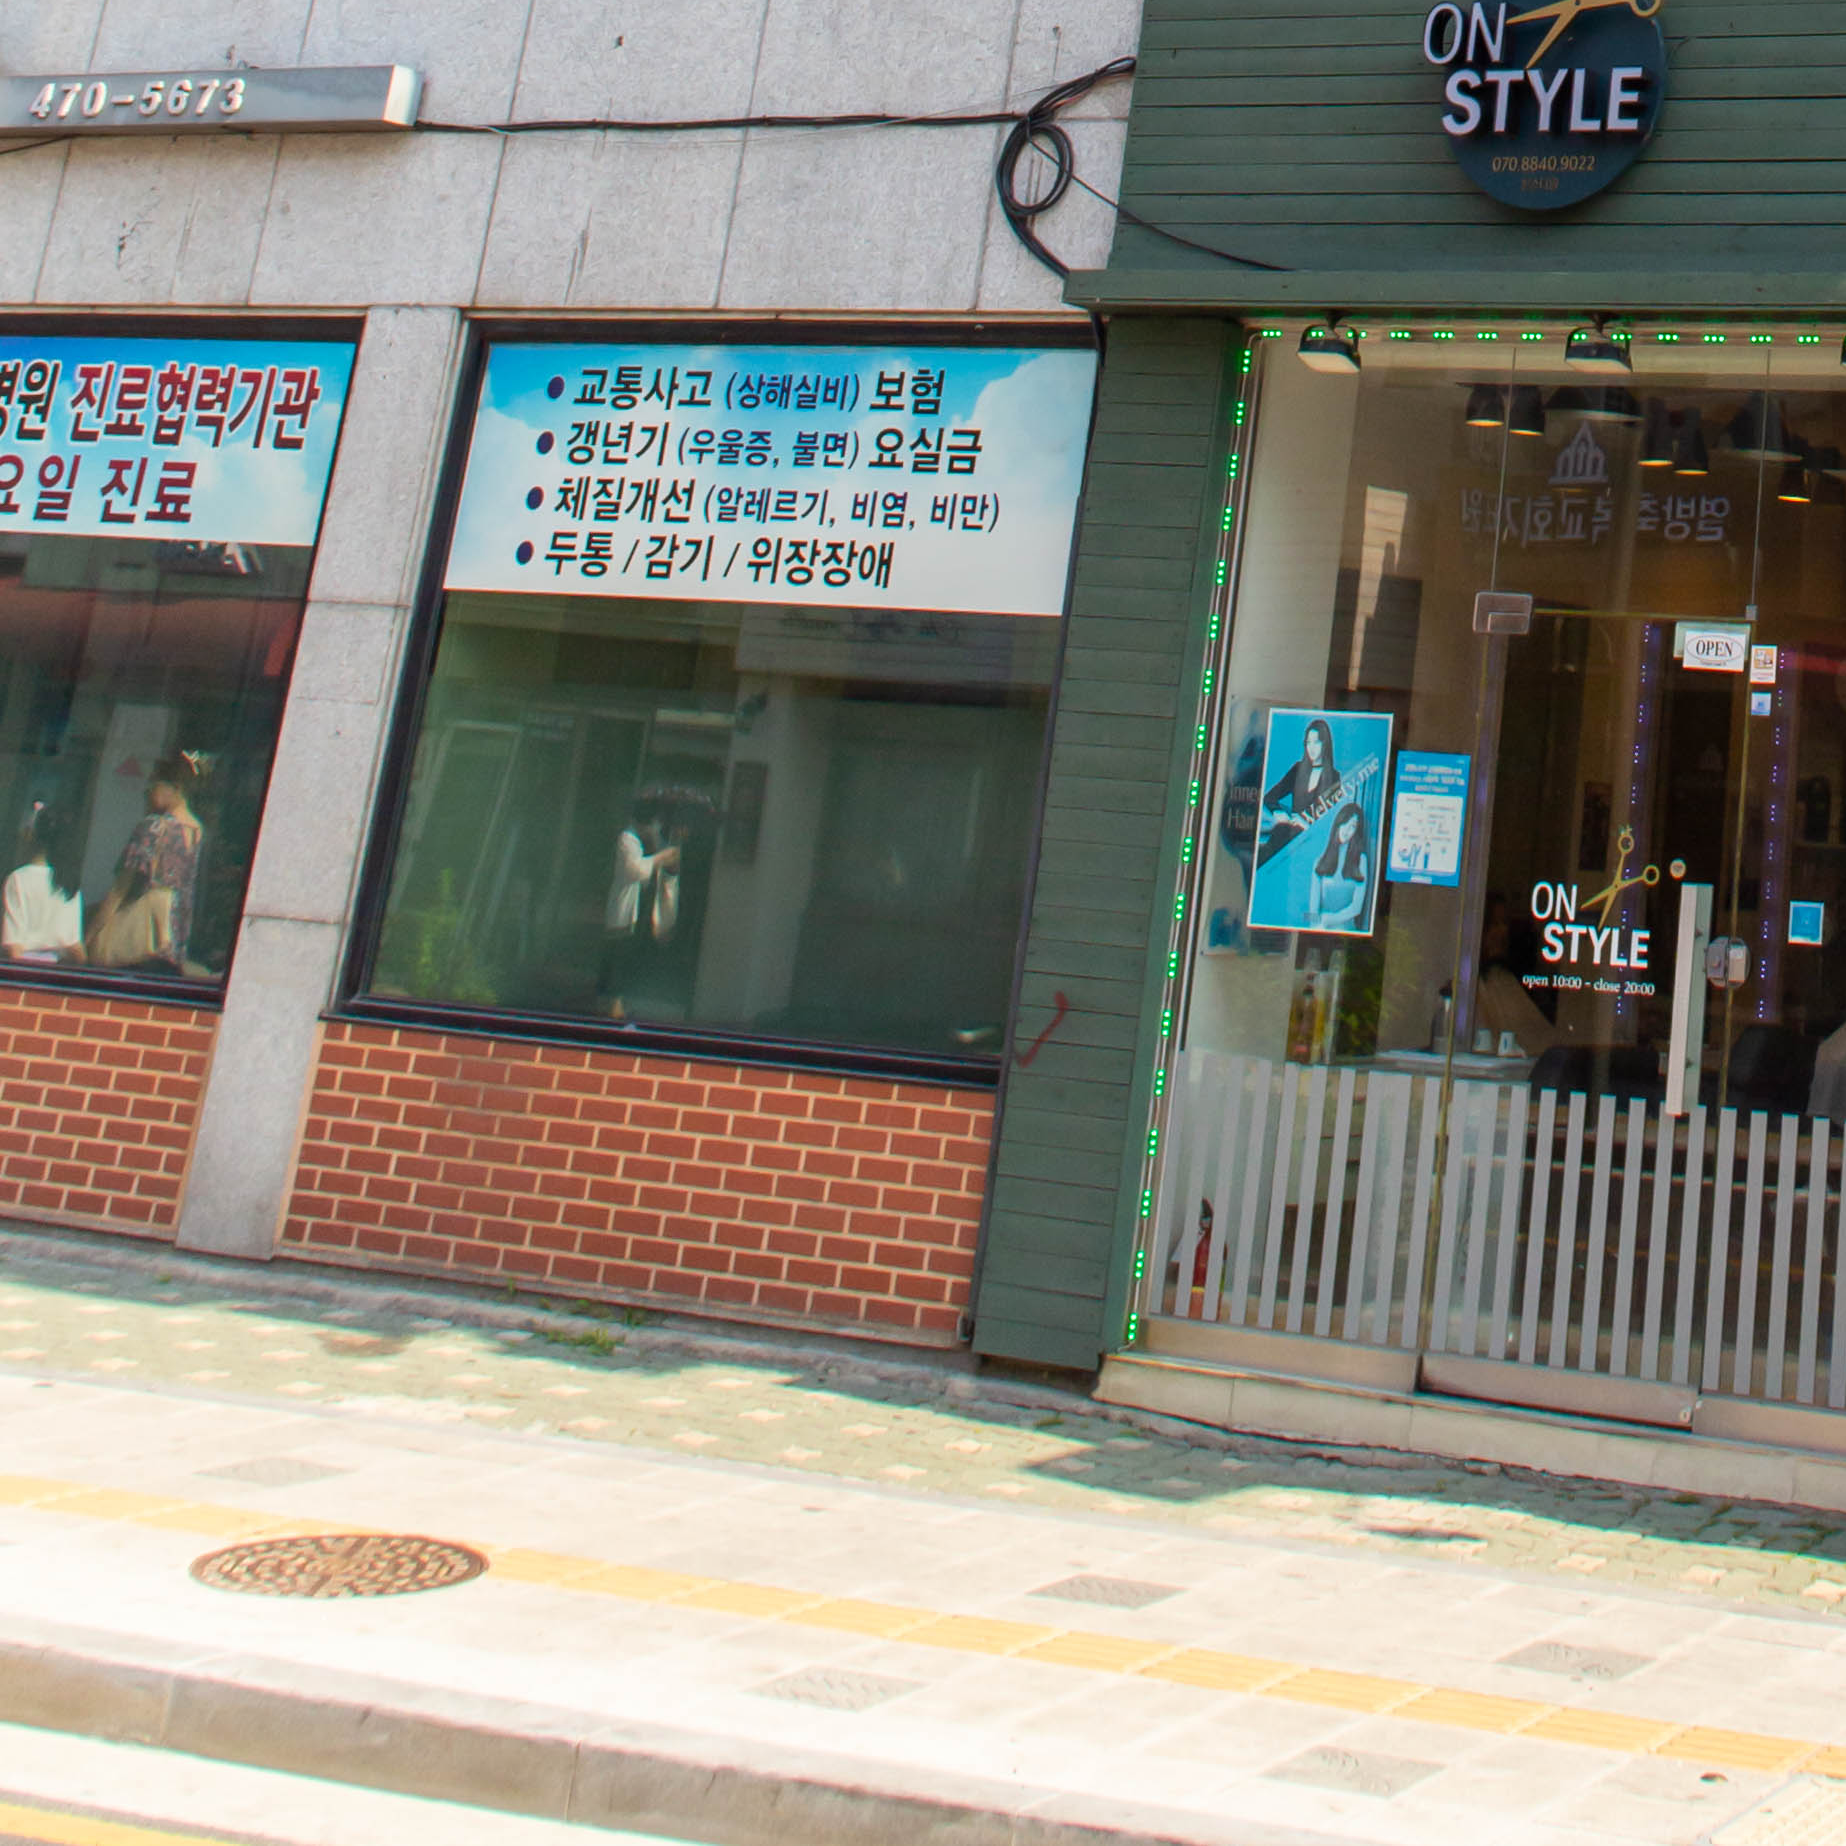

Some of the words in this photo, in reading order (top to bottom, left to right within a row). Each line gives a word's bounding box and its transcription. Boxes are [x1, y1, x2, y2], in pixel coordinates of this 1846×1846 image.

[1423, 2, 1507, 65] ON
[29, 77, 246, 119] 470-5673
[1441, 66, 1644, 136] STYLE
[69, 362, 322, 451] 진료협력기관
[573, 365, 714, 411] 교통사고
[726, 371, 861, 413] (상해실비)
[868, 368, 947, 416] 보험
[567, 419, 671, 467] 갱년기
[678, 426, 781, 469] (우울증,
[791, 430, 860, 470] 불면)
[868, 427, 984, 475] 요실금
[99, 456, 199, 524] 진료
[554, 475, 697, 524] 체질개선
[703, 483, 837, 529] (알레르기,
[850, 490, 916, 530] 비염,
[929, 492, 1001, 533] 비만)
[543, 530, 615, 578] 두통
[644, 533, 716, 582] 감기
[747, 535, 896, 589] 위장장애
[1695, 639, 1735, 657] OPEN
[1300, 756, 1380, 825] Velvety.me
[1531, 880, 1578, 921] ON
[1541, 921, 1651, 969] STYLE
[1522, 974, 1549, 989] open
[1551, 974, 1583, 990] 10:00
[1593, 977, 1621, 994] close
[1624, 980, 1656, 997] 20:00
